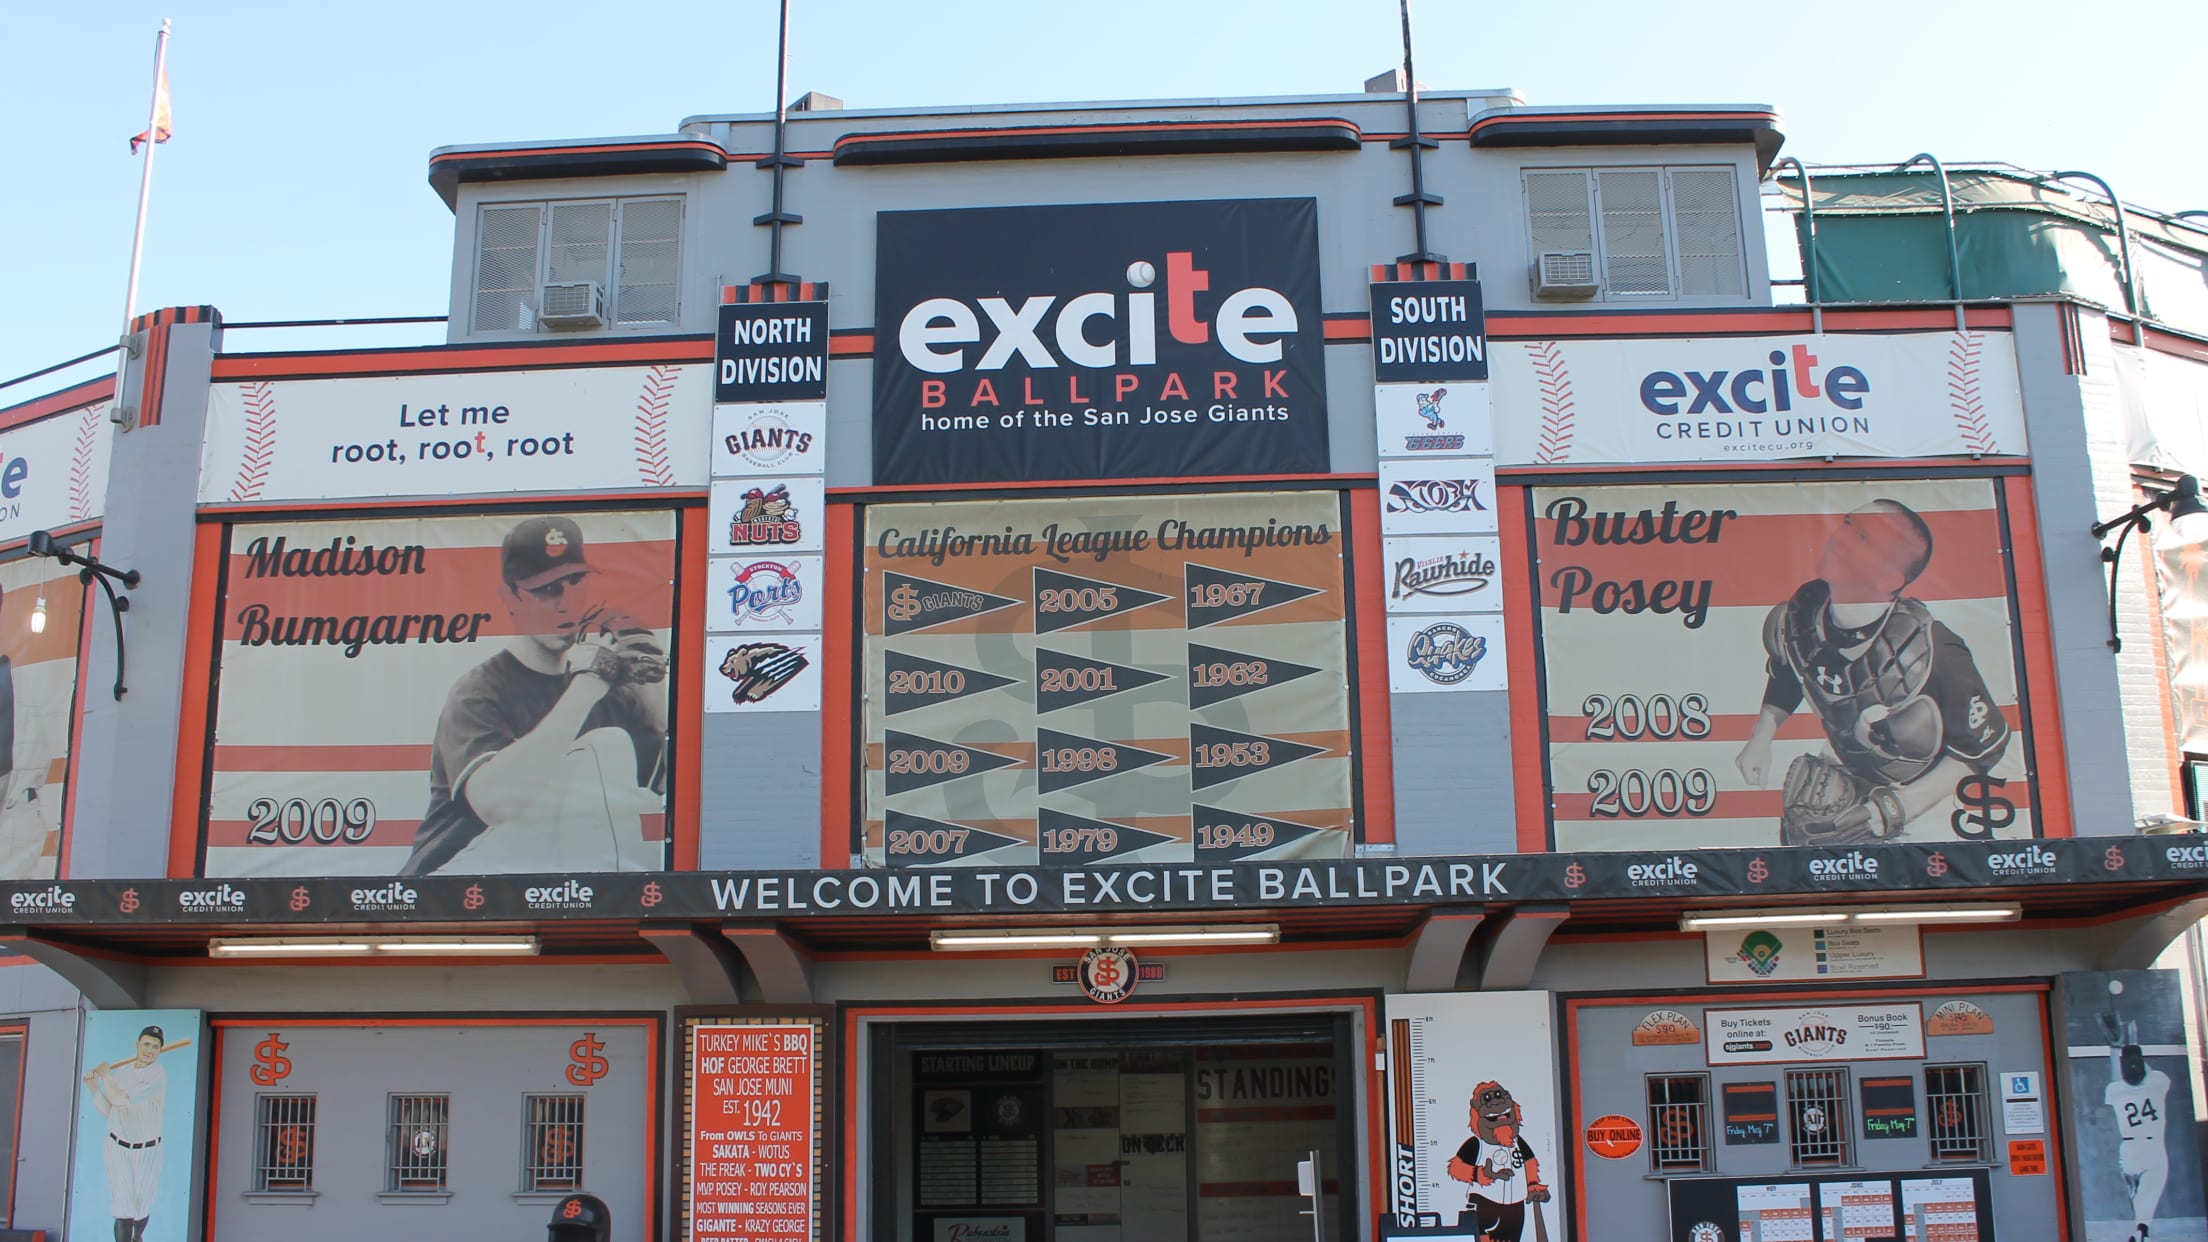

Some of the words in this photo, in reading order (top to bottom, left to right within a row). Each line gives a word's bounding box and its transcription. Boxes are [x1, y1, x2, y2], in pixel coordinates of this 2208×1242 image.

[899, 251, 1298, 373] excite
[1390, 296, 1466, 324] SOUTH
[734, 317, 811, 345] NORTH
[1380, 335, 1483, 364] DIVISION
[721, 356, 822, 384] DIVISION
[1639, 344, 1870, 415] excite
[921, 370, 1289, 409] BALLPARK
[399, 404, 449, 429] Let
[462, 405, 509, 426] me
[748, 409, 764, 420] SAN
[769, 408, 789, 419] JOSE
[921, 411, 989, 431] home
[1000, 408, 1024, 428] of
[1034, 407, 1073, 427] the
[1083, 406, 1129, 426] San
[1140, 404, 1198, 424] Jose
[1208, 403, 1289, 423] Giants
[1656, 421, 1762, 439] CREDIT
[1775, 417, 1869, 436] UNION
[332, 440, 406, 466] root,
[419, 431, 494, 462] root,
[507, 431, 574, 458] root
[725, 428, 813, 455] GIANTS
[1723, 440, 1813, 452] excitecu.org
[1545, 496, 1737, 546] Buster
[730, 521, 801, 546] NUTS
[877, 525, 1037, 567] California
[1041, 522, 1151, 564] League
[1156, 518, 1332, 557] Champions
[244, 535, 427, 580] Madison
[749, 563, 783, 572] STOCKTON
[1392, 552, 1495, 600] Rawhide
[727, 577, 802, 616] Ports
[922, 590, 984, 612] GIANTS
[1039, 587, 1118, 613] 2005
[1191, 582, 1266, 608] 1967
[1550, 566, 1712, 629] Posey
[237, 603, 492, 658] Bumgarner
[888, 670, 966, 695] 2010
[1041, 667, 1117, 693] 2001
[1193, 662, 1268, 687] 1962
[1583, 692, 1712, 740] 2008
[889, 750, 970, 775] 2009
[1041, 748, 1118, 773] 1998
[1195, 742, 1270, 768] 1953
[1587, 767, 1717, 817] 2009
[246, 797, 377, 845] 2009
[889, 829, 970, 854] 2007
[1043, 828, 1118, 853] 1979
[1198, 823, 1275, 849] 1949
[1627, 856, 1698, 880] excite
[1808, 850, 1878, 874] excite
[1987, 845, 2057, 869] excite
[1667, 878, 1697, 886] UNION
[1813, 873, 1846, 881] CREDIT
[1848, 872, 1878, 880] UNION
[1992, 868, 2025, 876] CREDIT
[2027, 866, 2056, 875] UNION
[11, 886, 76, 907] excite
[179, 884, 246, 906] excite
[351, 881, 418, 904] excite
[524, 879, 593, 903] excite
[710, 875, 952, 910] WELCOME
[976, 873, 1038, 905] TO
[1063, 869, 1234, 904] EXCITE
[1259, 862, 1509, 901] BALLPARK
[45, 906, 73, 914] UNION
[182, 905, 213, 913] CREDIT
[353, 903, 385, 911] CREDIT
[528, 901, 561, 910] CREDIT
[563, 901, 592, 909] UNION
[1056, 968, 1075, 980] EST
[1089, 988, 1126, 1001] GIANTS
[1641, 1011, 1664, 1032] FLEX
[1667, 1011, 1690, 1029] PLAN
[1721, 1019, 1737, 1028] Buy
[1740, 1018, 1771, 1027] Tickets
[1858, 1014, 1884, 1023] Bonus
[1886, 1013, 1907, 1022] Book
[1936, 1002, 1956, 1021] MINI
[1959, 1002, 1985, 1020] PLAN
[700, 1034, 740, 1052] TURKEY
[783, 1034, 807, 1055] BBQ
[1727, 1030, 1754, 1038] online
[1784, 1025, 1847, 1047] GIANTS
[727, 1056, 770, 1074] GEORGE
[773, 1056, 807, 1074] BRETT
[921, 1055, 985, 1073] STARTING
[988, 1055, 1035, 1072] LINEUP
[713, 1078, 734, 1096] SAN
[736, 1078, 762, 1096] JOSE
[765, 1078, 792, 1096] MUNI
[1197, 1065, 1336, 1100] STANDING
[723, 1099, 740, 1114] EST.
[743, 1099, 781, 1127] 1942
[2124, 1097, 2158, 1128] 24
[700, 1130, 724, 1140] From
[726, 1130, 755, 1141] OWLS
[758, 1130, 767, 1140] To
[769, 1130, 803, 1141] GIANTS
[1588, 1129, 1605, 1142] BUY
[1609, 1128, 1641, 1141] ONLINE
[1867, 1118, 1889, 1134] Friday
[712, 1144, 749, 1159] SAKATA
[758, 1144, 790, 1159] WOTUS
[700, 1162, 716, 1177] THE
[719, 1162, 746, 1177] FREAK
[754, 1163, 777, 1177] TWO
[697, 1182, 714, 1196] MVP
[716, 1182, 742, 1196] POSEY
[750, 1182, 767, 1196] ROY
[769, 1182, 807, 1196] PEARSON
[1398, 1145, 1415, 1228] SHORT
[697, 1202, 716, 1214] MOST
[717, 1202, 754, 1214] WINNING
[755, 1202, 787, 1214] SEASONS
[788, 1202, 806, 1214] EVER
[697, 1219, 736, 1232] GIGANTE
[745, 1219, 771, 1232] KRAZY
[772, 1219, 805, 1232] GEORGE
